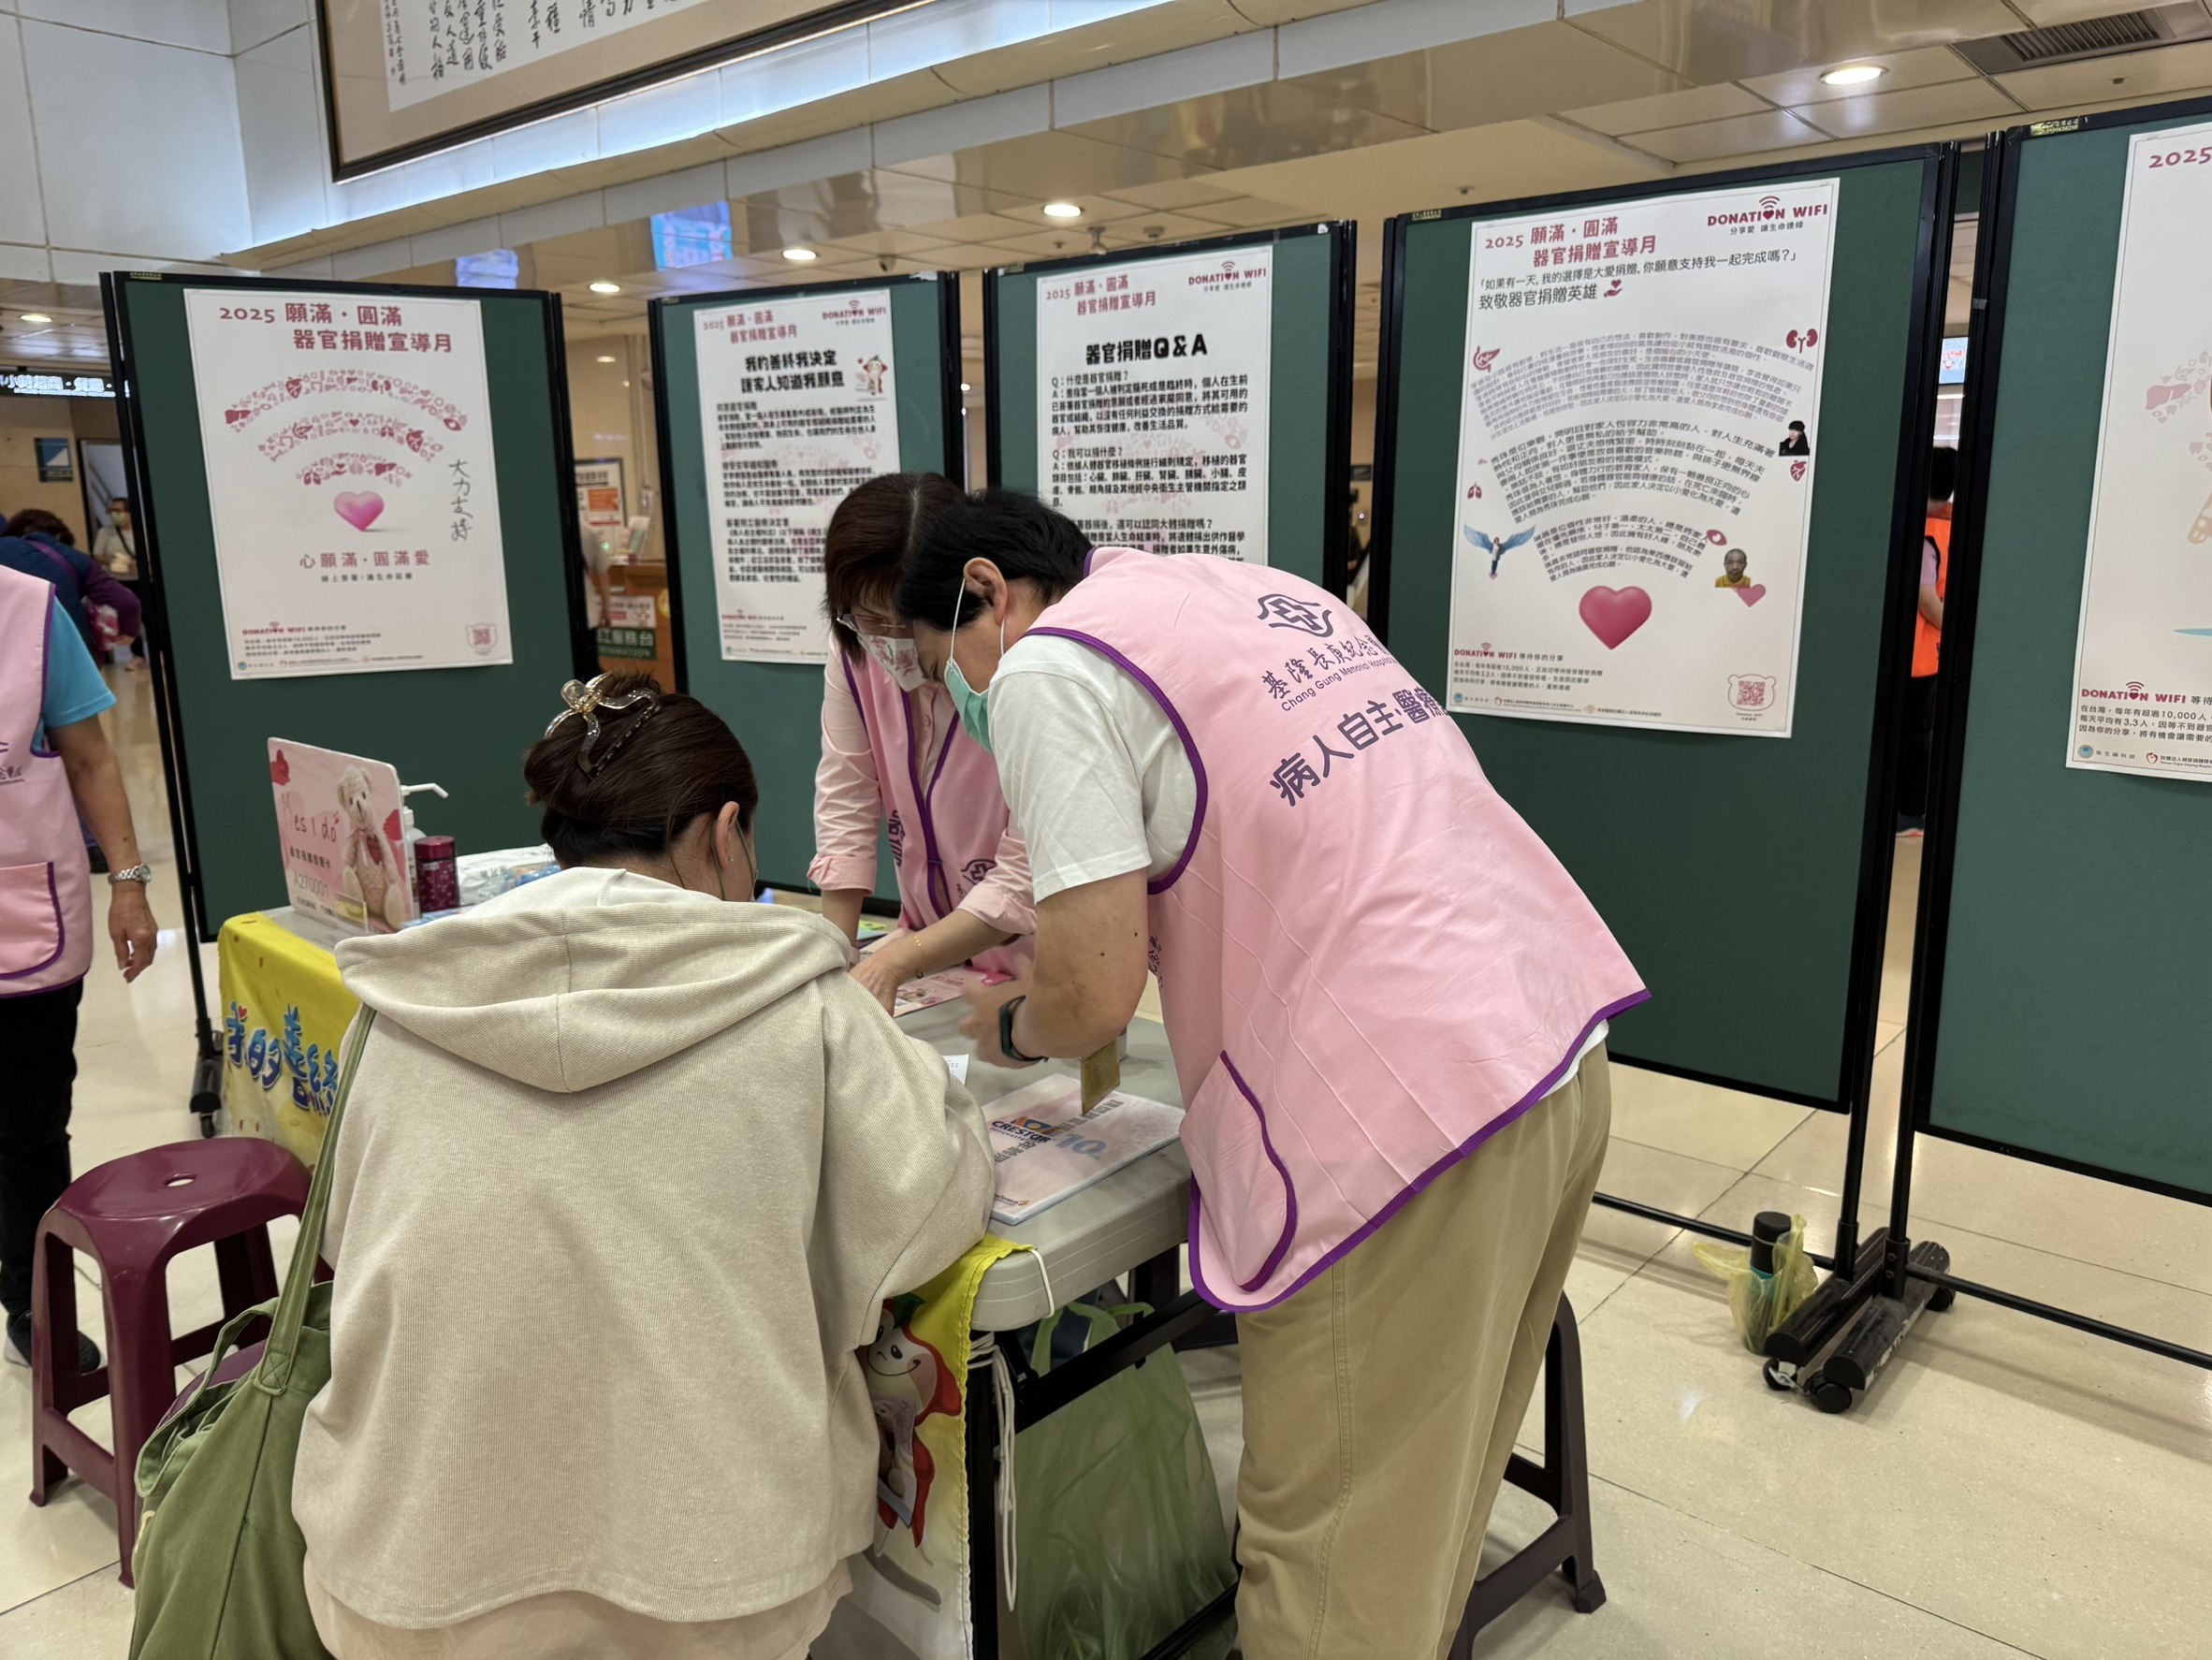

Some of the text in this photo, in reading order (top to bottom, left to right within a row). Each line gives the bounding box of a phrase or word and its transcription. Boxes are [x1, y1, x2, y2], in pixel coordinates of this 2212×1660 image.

[2148, 146, 2212, 169] 2025
[1793, 204, 1827, 219] WIFI
[1485, 235, 1523, 249] 2025
[1534, 235, 1655, 268] 器官捐贈宣導月
[1244, 269, 1266, 280] WIFI
[1045, 289, 1070, 300] 2025
[1077, 290, 1156, 315] 器官捐贈宣導月
[1478, 284, 1597, 311] 致敬器官捐贈英雄
[219, 305, 275, 324] 2025
[293, 329, 453, 353] 器官捐贈宣導月
[1261, 635, 1387, 699] 基隆長庚紀念
[1281, 687, 1317, 711] Chang
[1315, 672, 1342, 690] Gung
[2155, 693, 2186, 704] WIFI
[992, 1120, 1052, 1143] CRESTOR
